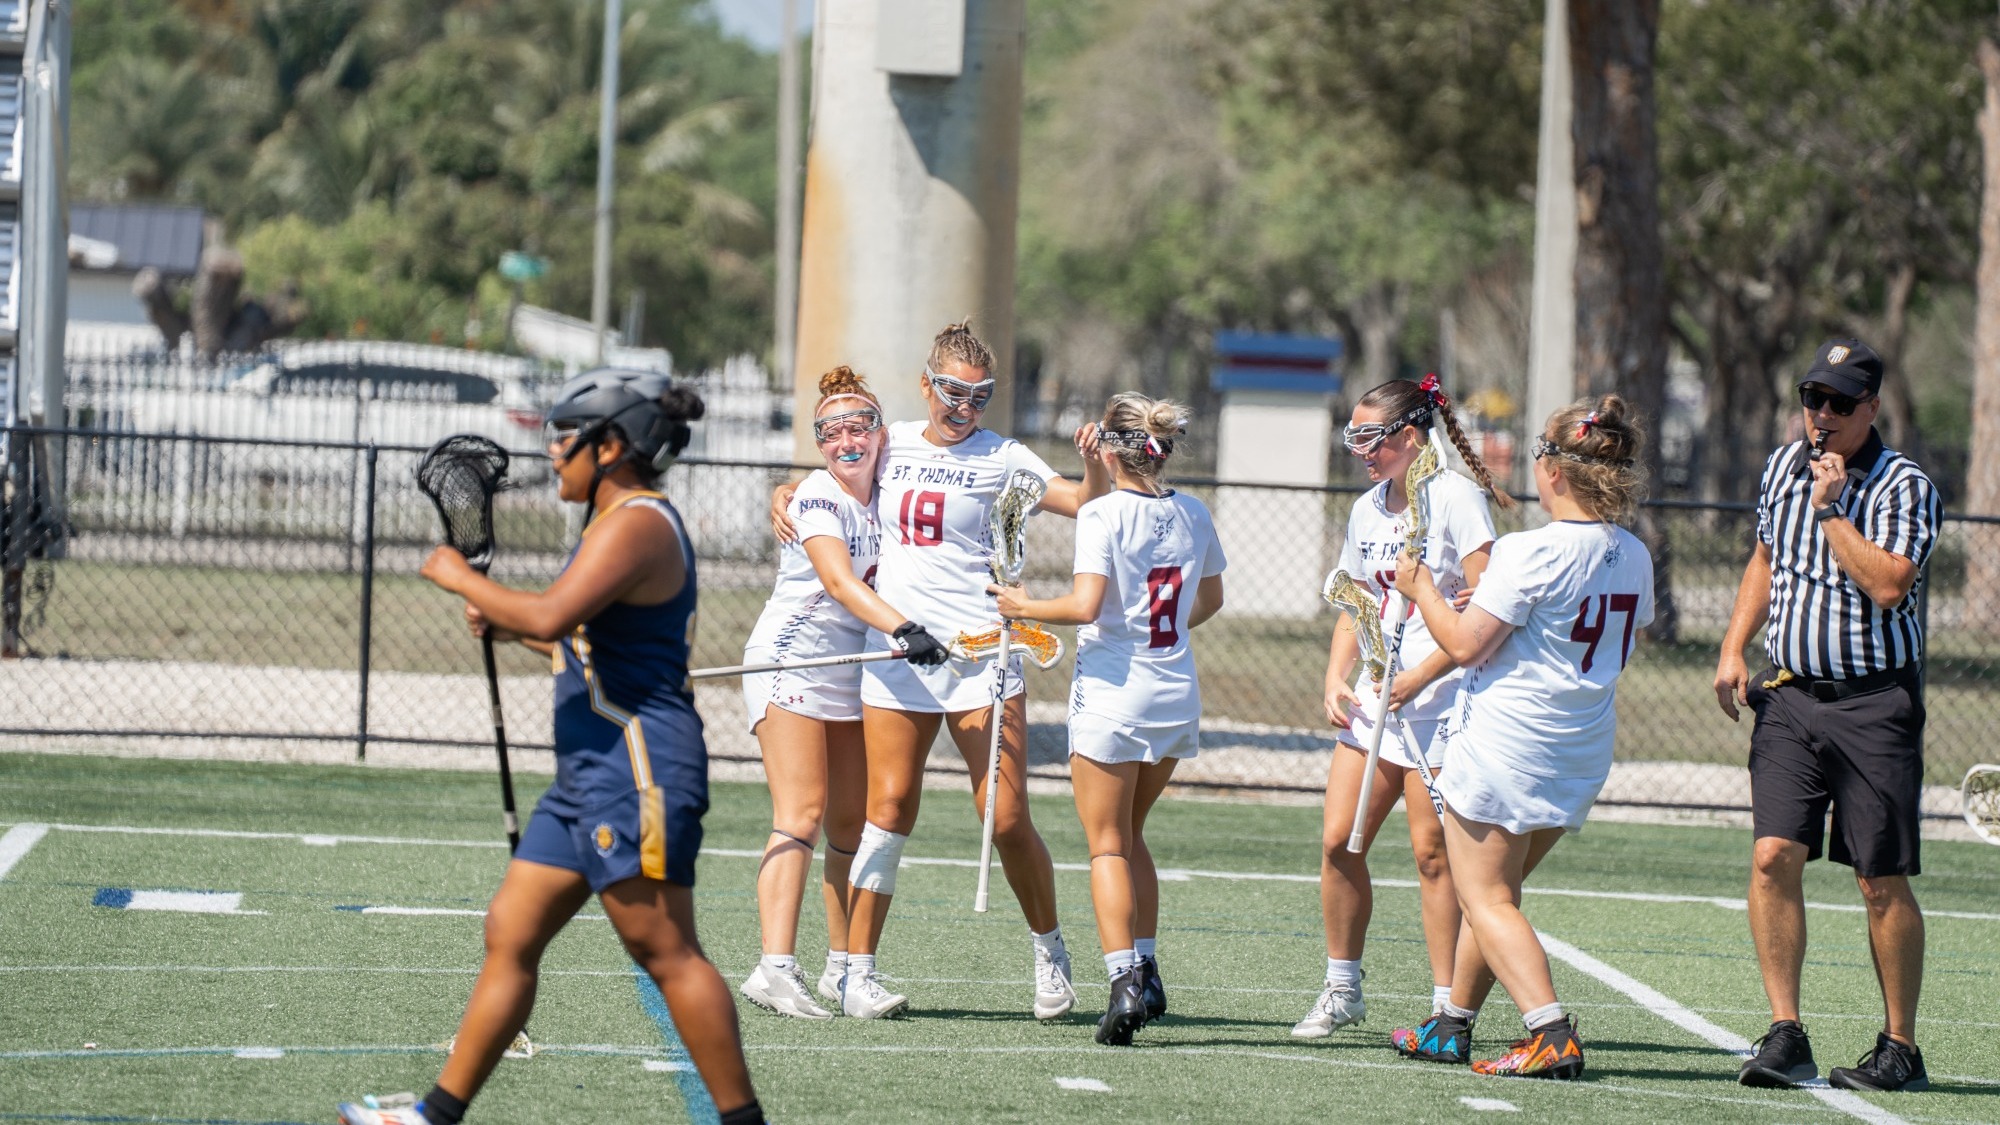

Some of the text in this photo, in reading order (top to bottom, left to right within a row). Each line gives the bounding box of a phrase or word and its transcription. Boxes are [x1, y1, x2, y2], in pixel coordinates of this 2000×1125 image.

[1104, 431, 1120, 439] STX
[1125, 431, 1147, 439] STX
[1385, 418, 1405, 435] STX
[892, 466, 978, 488] ST. THOMAS
[899, 489, 946, 547] 18
[1147, 566, 1183, 649] 8
[1391, 622, 1405, 656] STX
[1570, 594, 1640, 674] 47
[996, 668, 1006, 702] STX
[1425, 781, 1444, 815] STX
